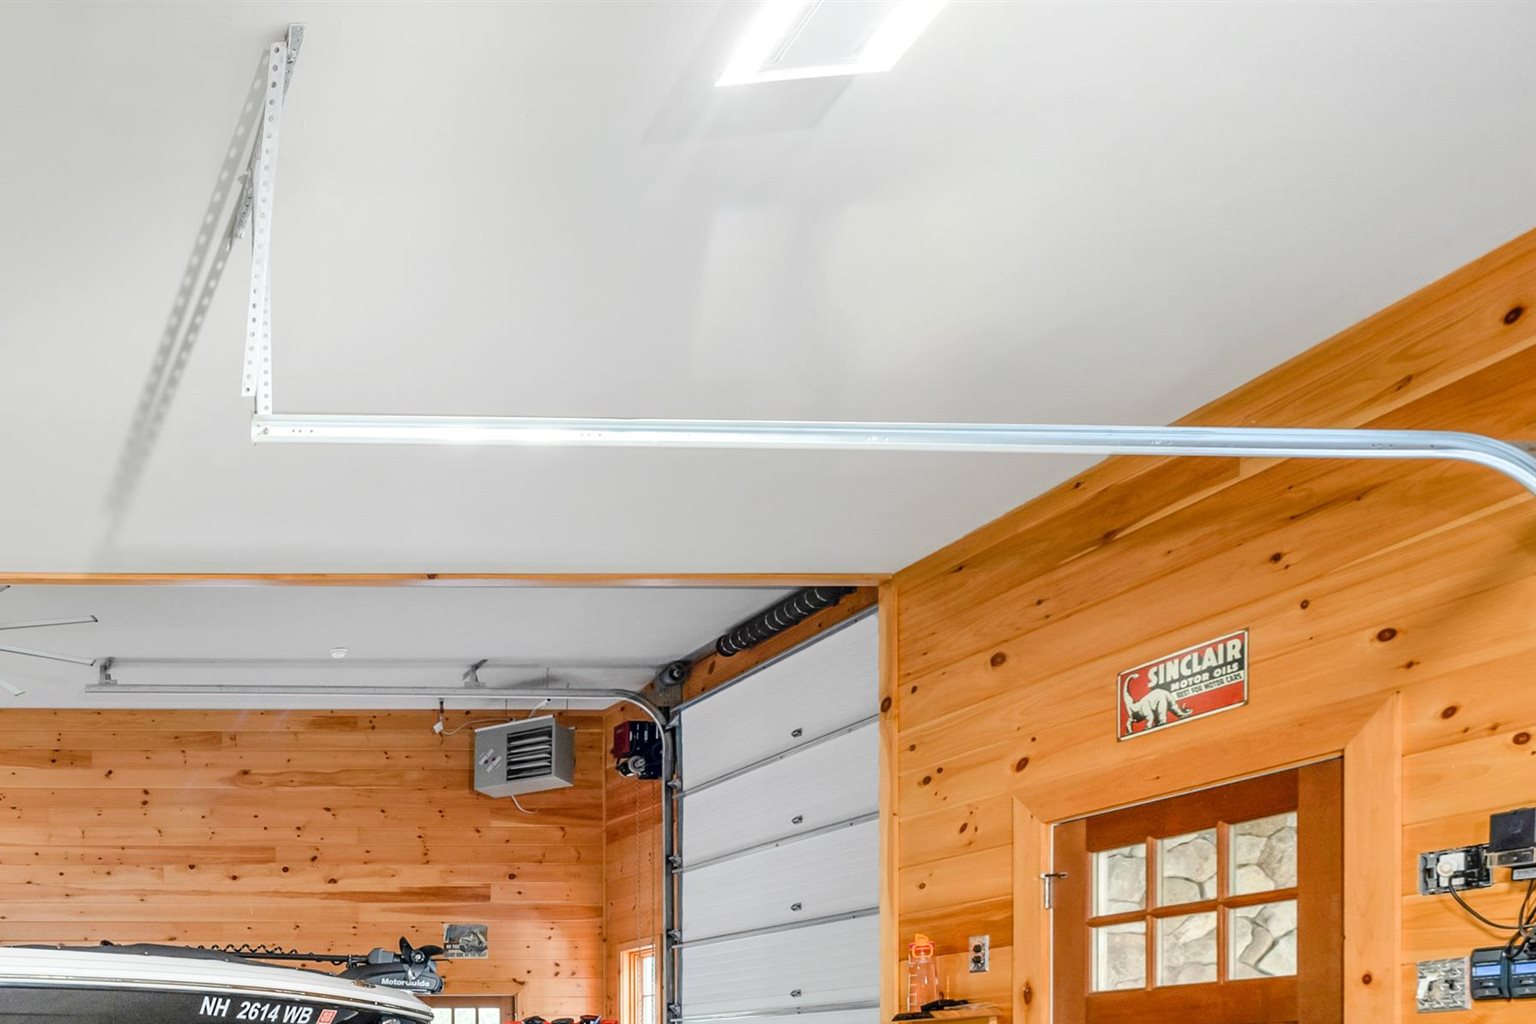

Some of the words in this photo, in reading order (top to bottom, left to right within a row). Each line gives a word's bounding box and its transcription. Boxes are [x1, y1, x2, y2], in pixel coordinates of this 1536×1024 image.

[1147, 639, 1242, 688] SINCLAIR
[1170, 671, 1209, 691] MOTOR
[1213, 662, 1239, 678] OILS
[199, 996, 231, 1018] NH
[236, 1001, 281, 1022] 2614
[282, 1005, 314, 1024] WB
